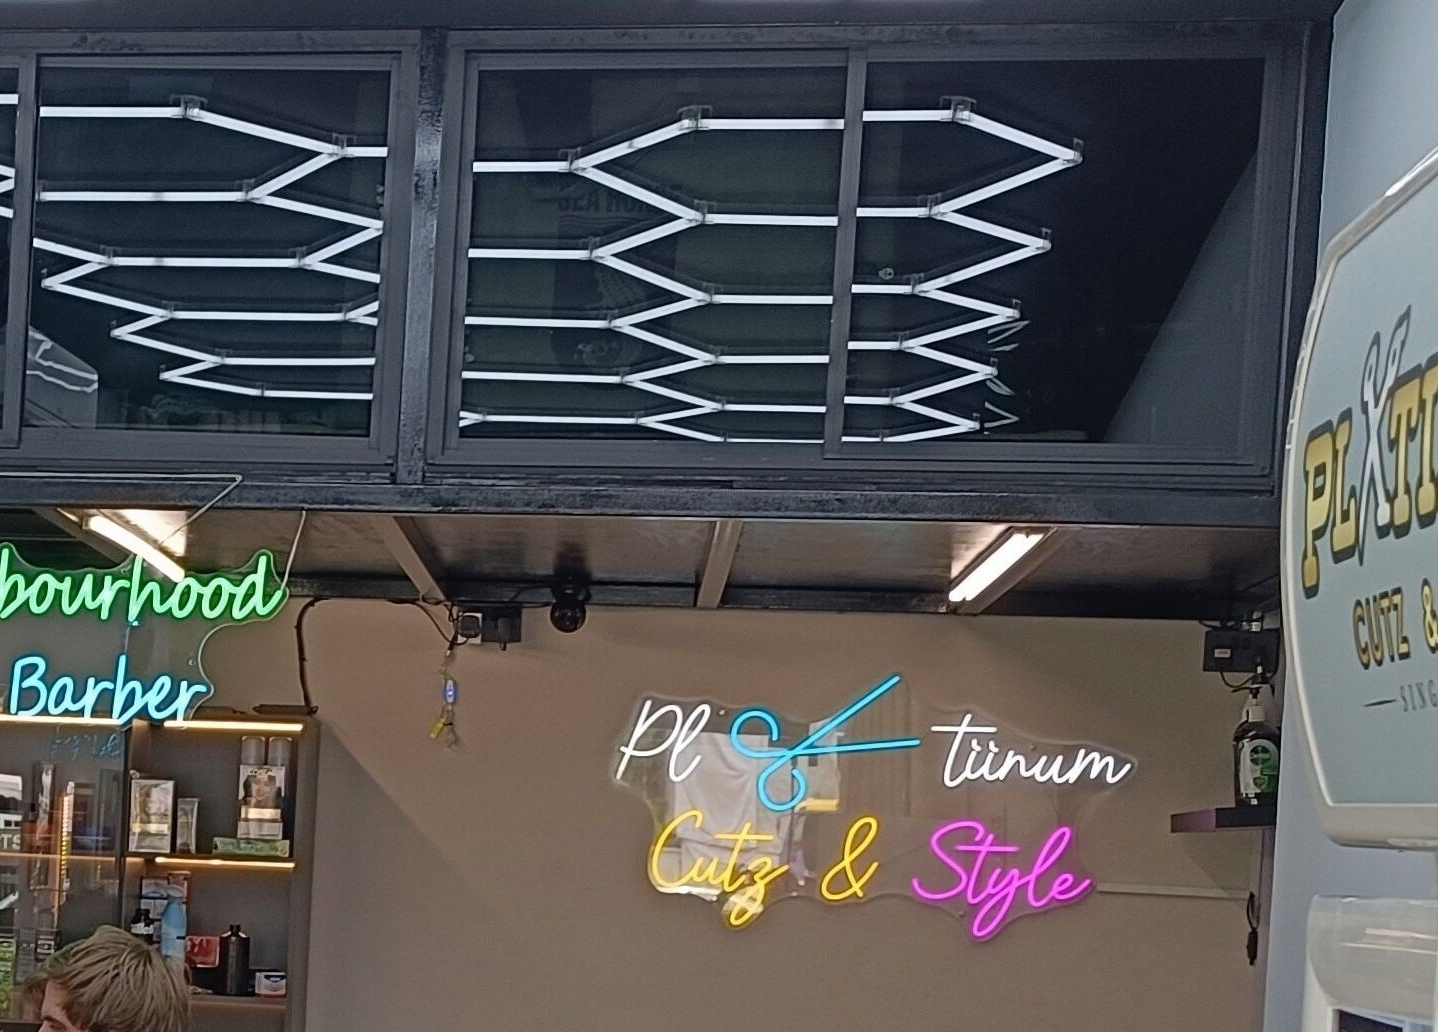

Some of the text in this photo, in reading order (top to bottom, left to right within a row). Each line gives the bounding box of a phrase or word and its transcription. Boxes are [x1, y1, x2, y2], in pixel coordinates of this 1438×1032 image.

[1353, 586, 1412, 671] CUTZ
[9, 654, 208, 725] Barber
[650, 809, 1093, 938] Cutz & Style
